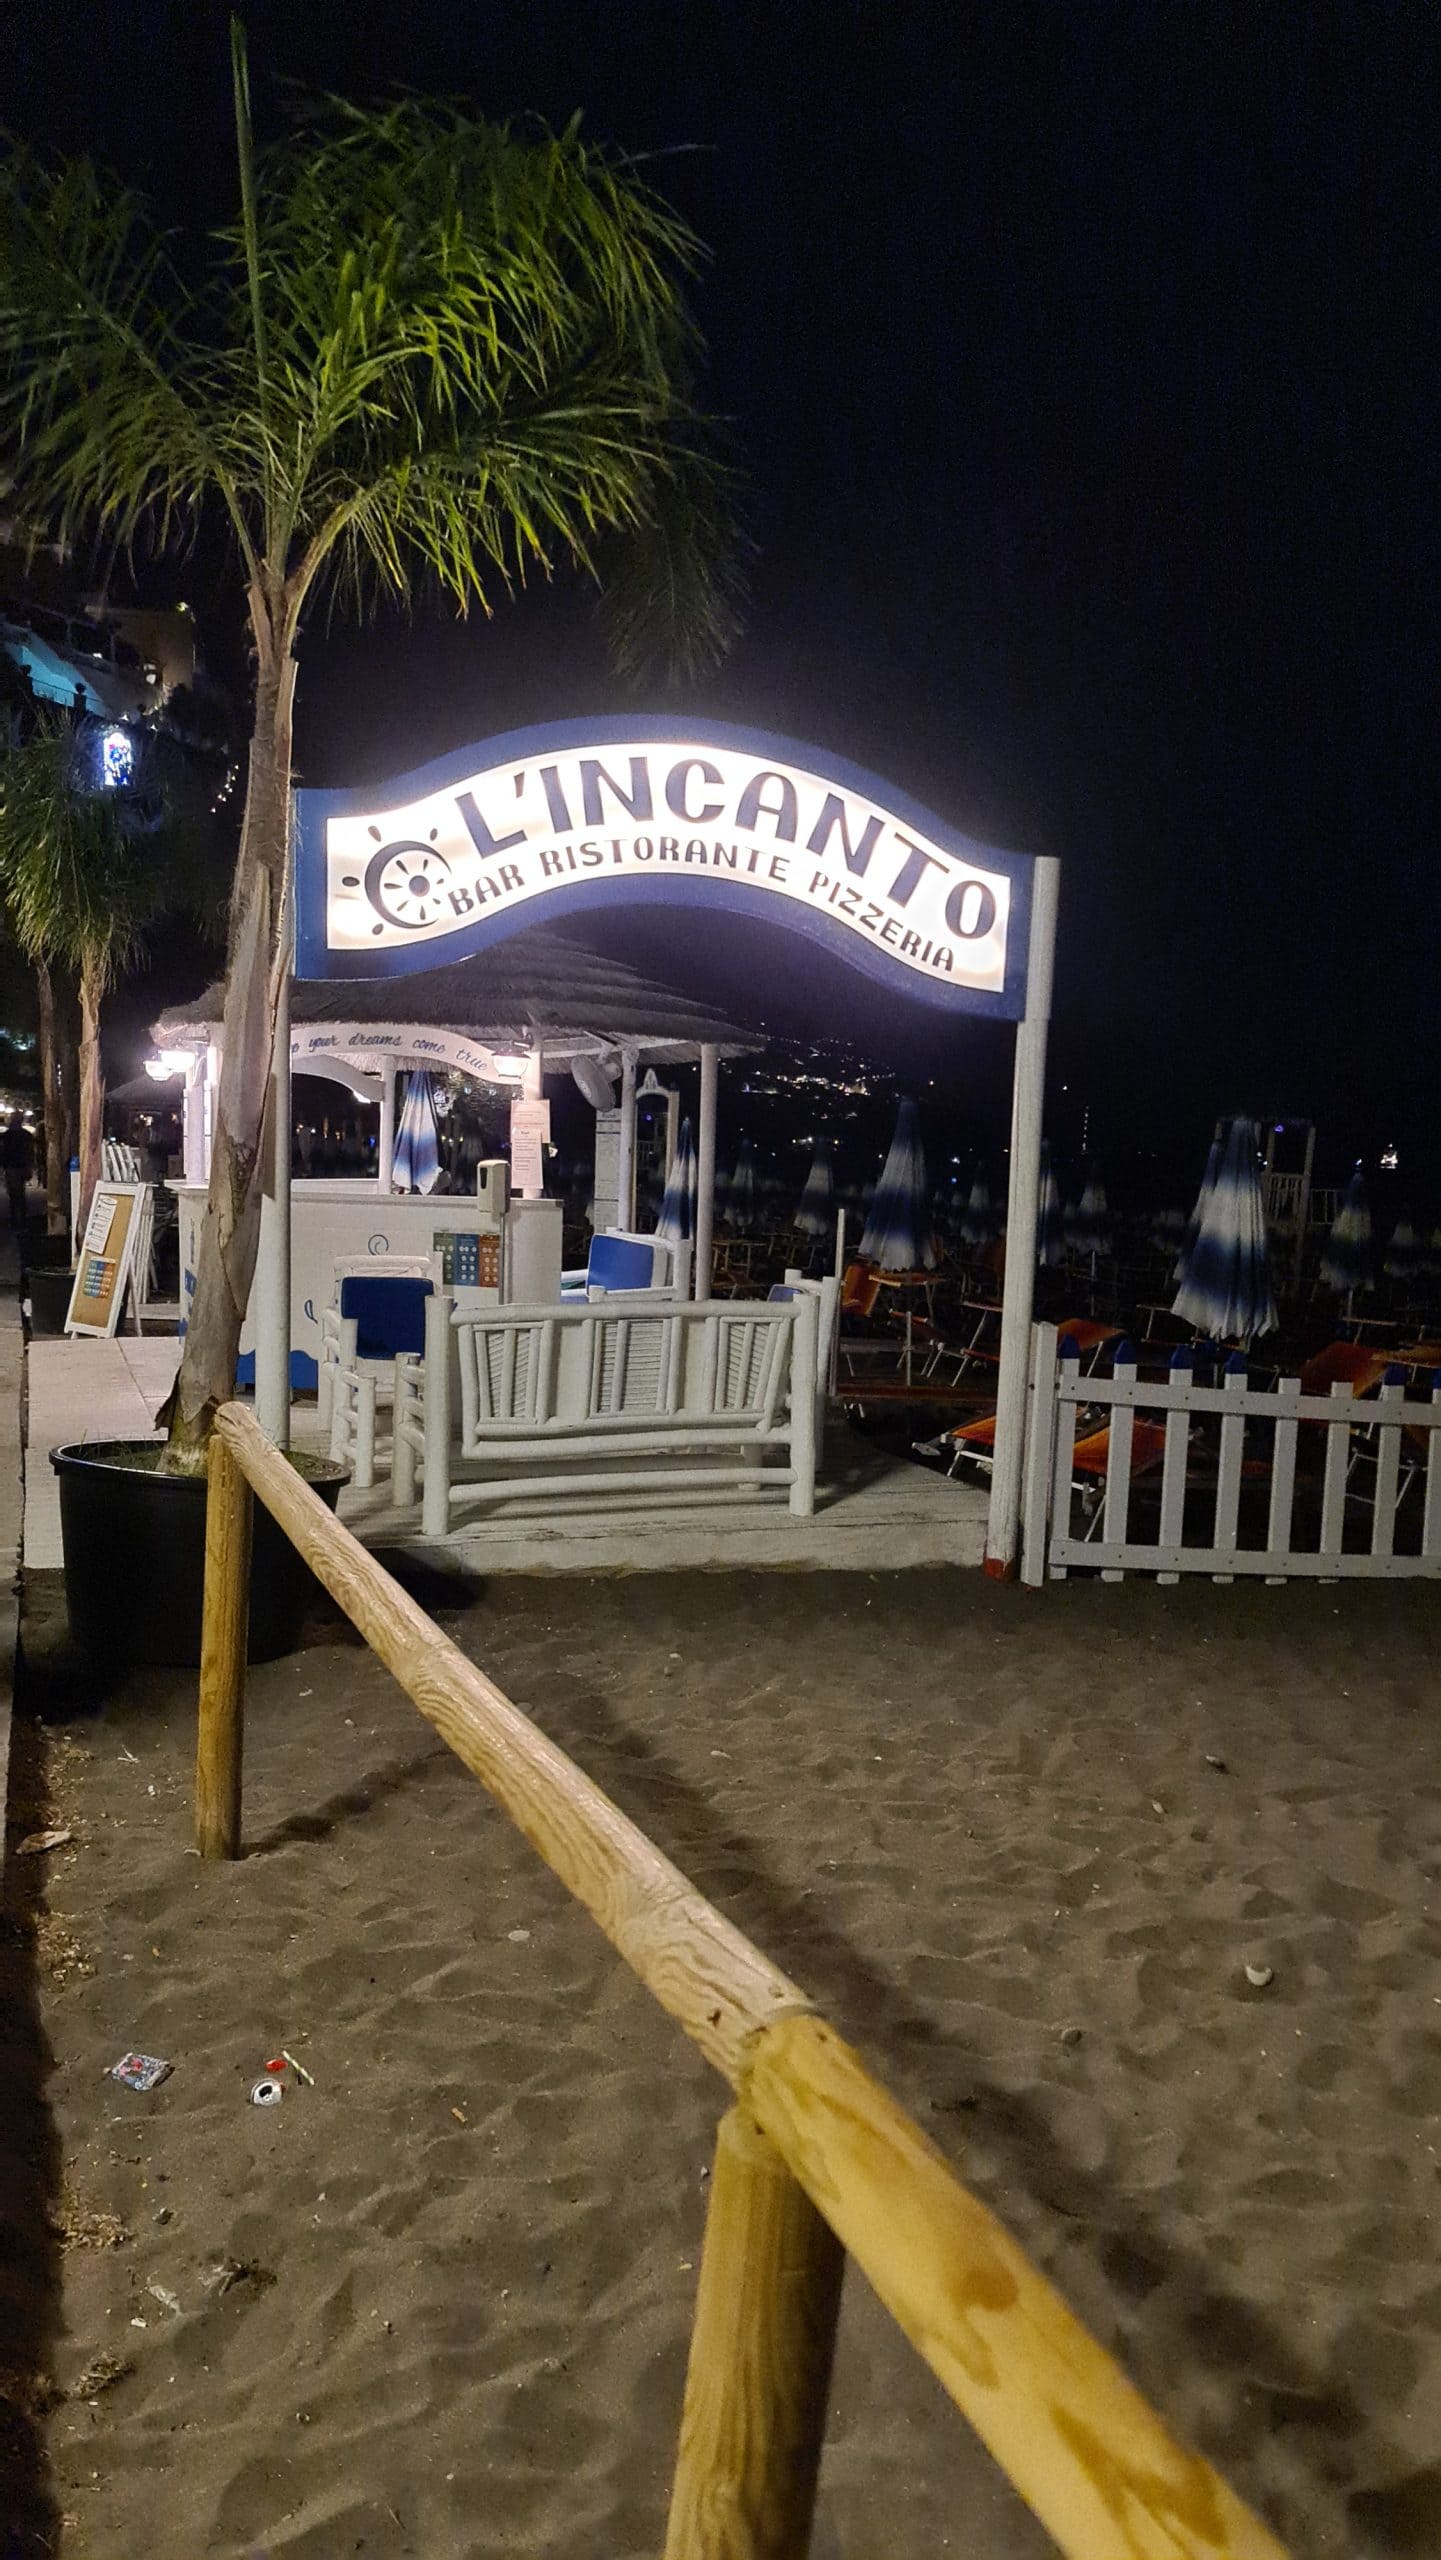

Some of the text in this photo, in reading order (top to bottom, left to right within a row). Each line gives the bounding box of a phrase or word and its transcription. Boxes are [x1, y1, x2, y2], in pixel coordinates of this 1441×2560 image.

[447, 835, 955, 972] BAR RISTORANTE PIZZERIA
[454, 756, 997, 940] L'INCANTO
[308, 1034, 340, 1053] your
[347, 1032, 403, 1047] dreams
[412, 1039, 446, 1054] come
[455, 1048, 488, 1071] true
